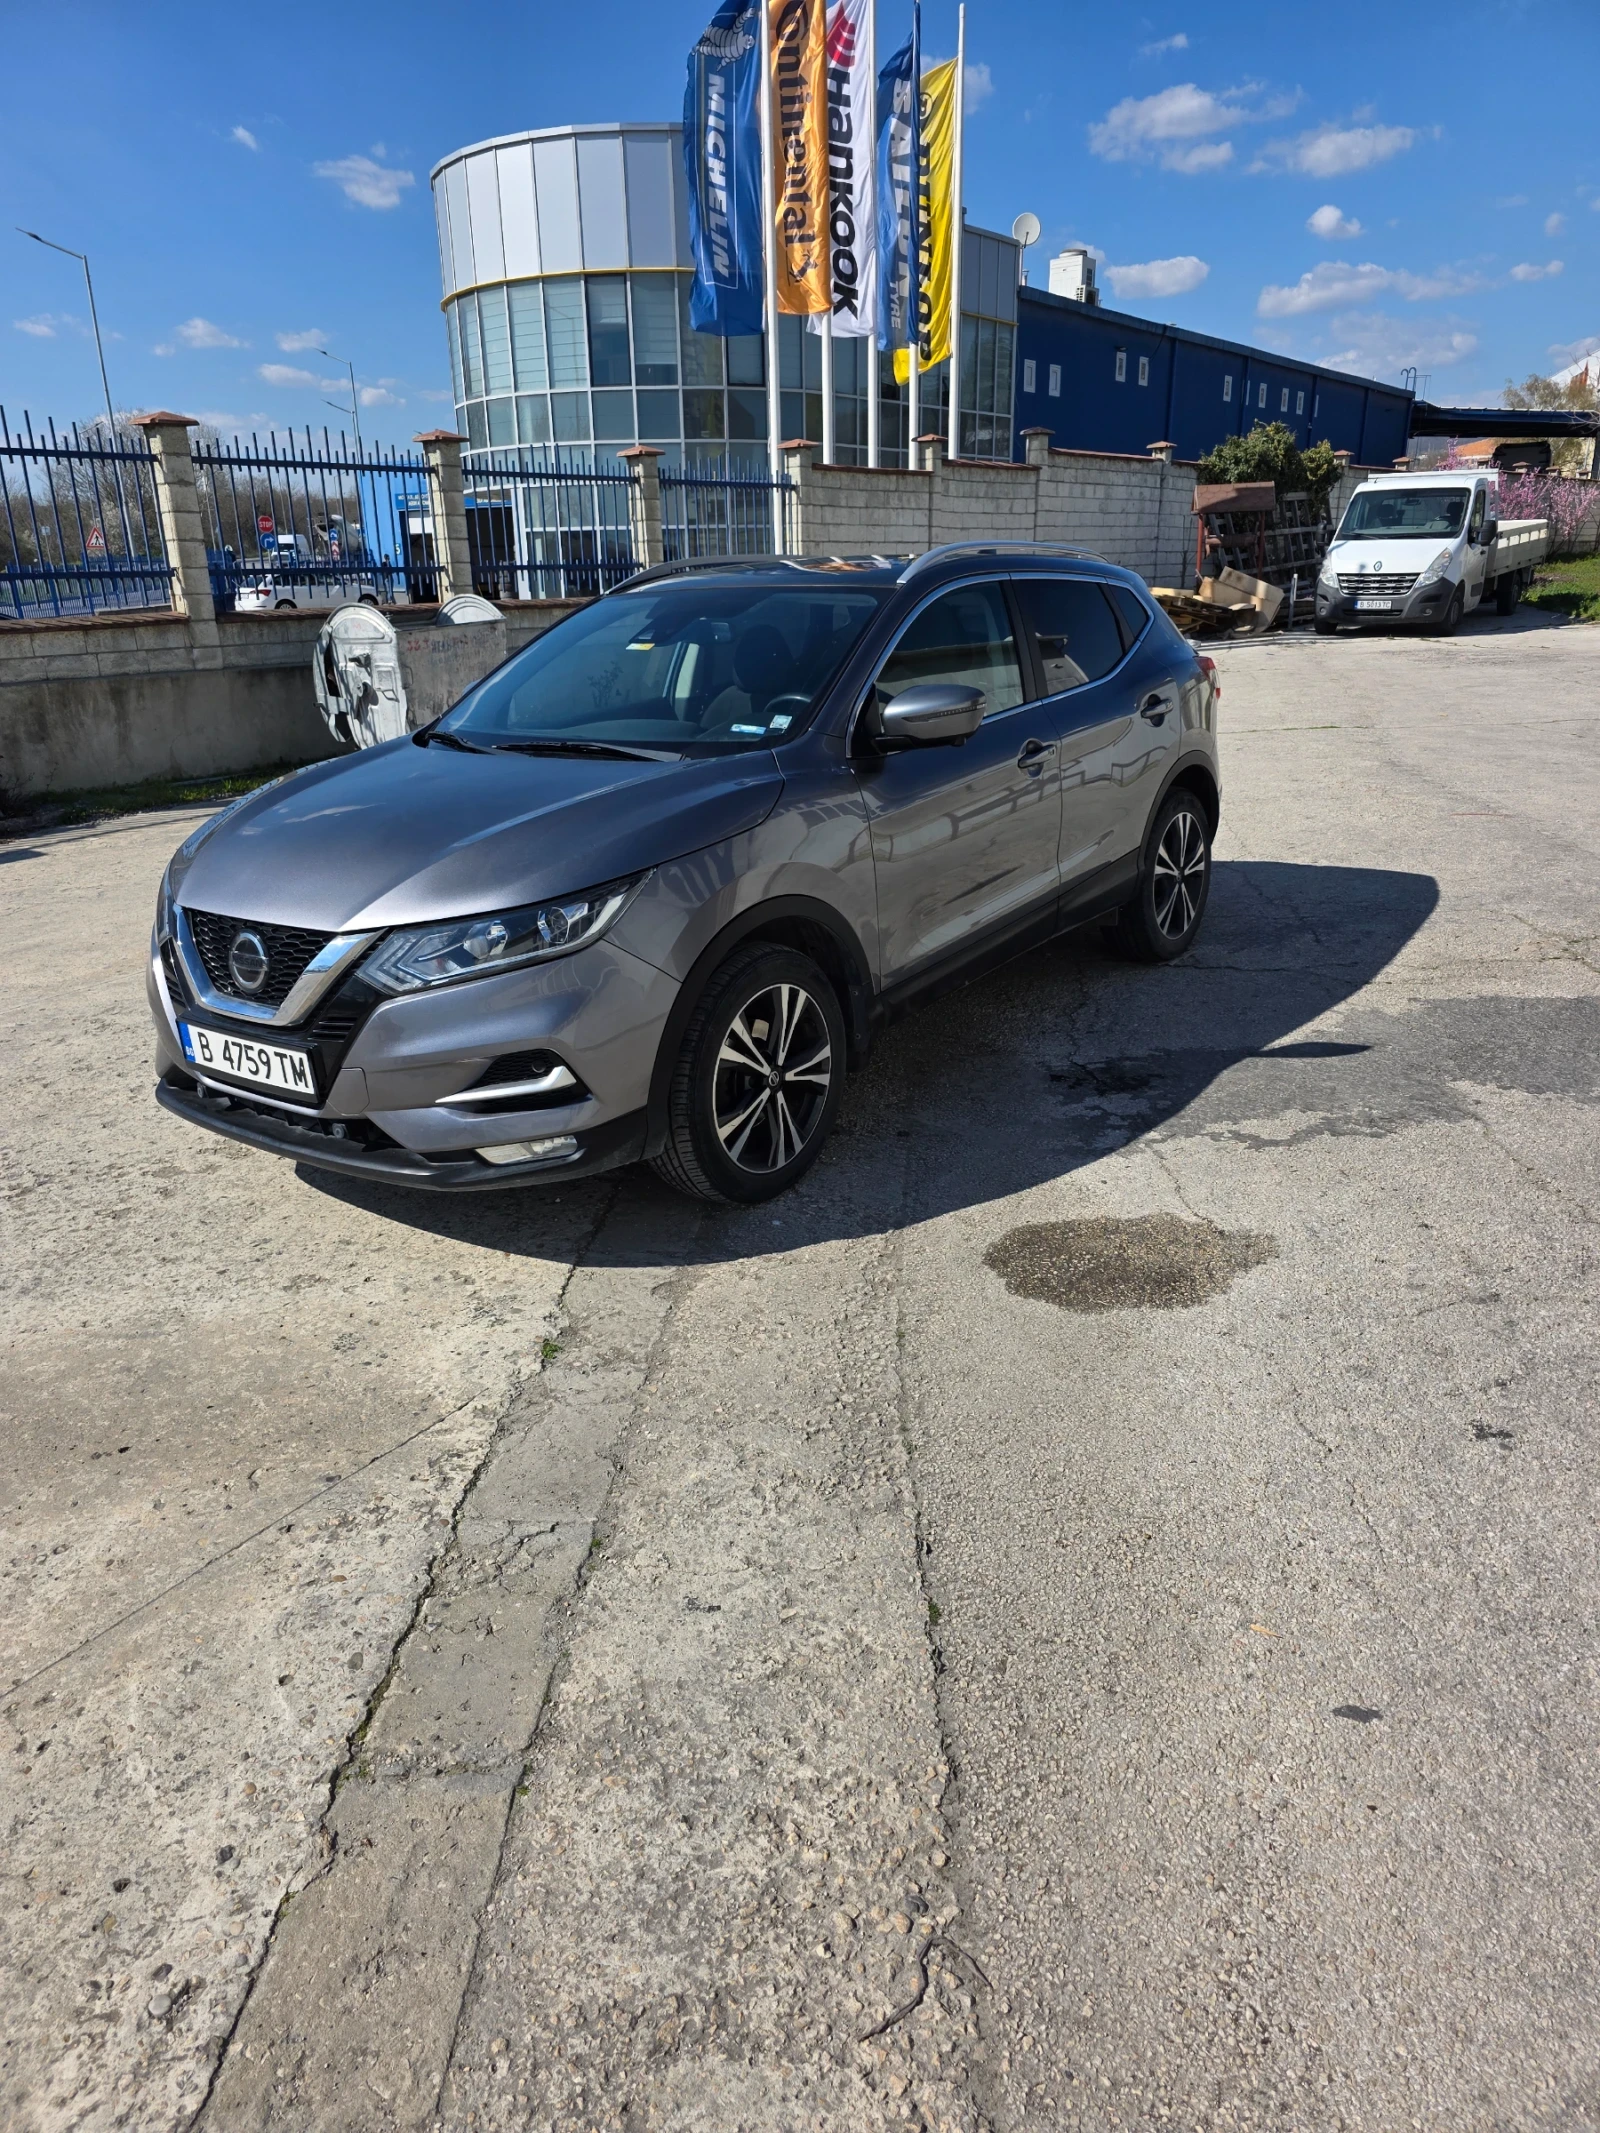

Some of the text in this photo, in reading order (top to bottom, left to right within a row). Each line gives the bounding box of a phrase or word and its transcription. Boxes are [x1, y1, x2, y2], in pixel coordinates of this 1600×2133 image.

[708, 73, 730, 278] MICHELIN
[776, 0, 815, 247] Continental
[890, 280, 902, 329] TYRE
[198, 1032, 309, 1089] B 4759 TM
